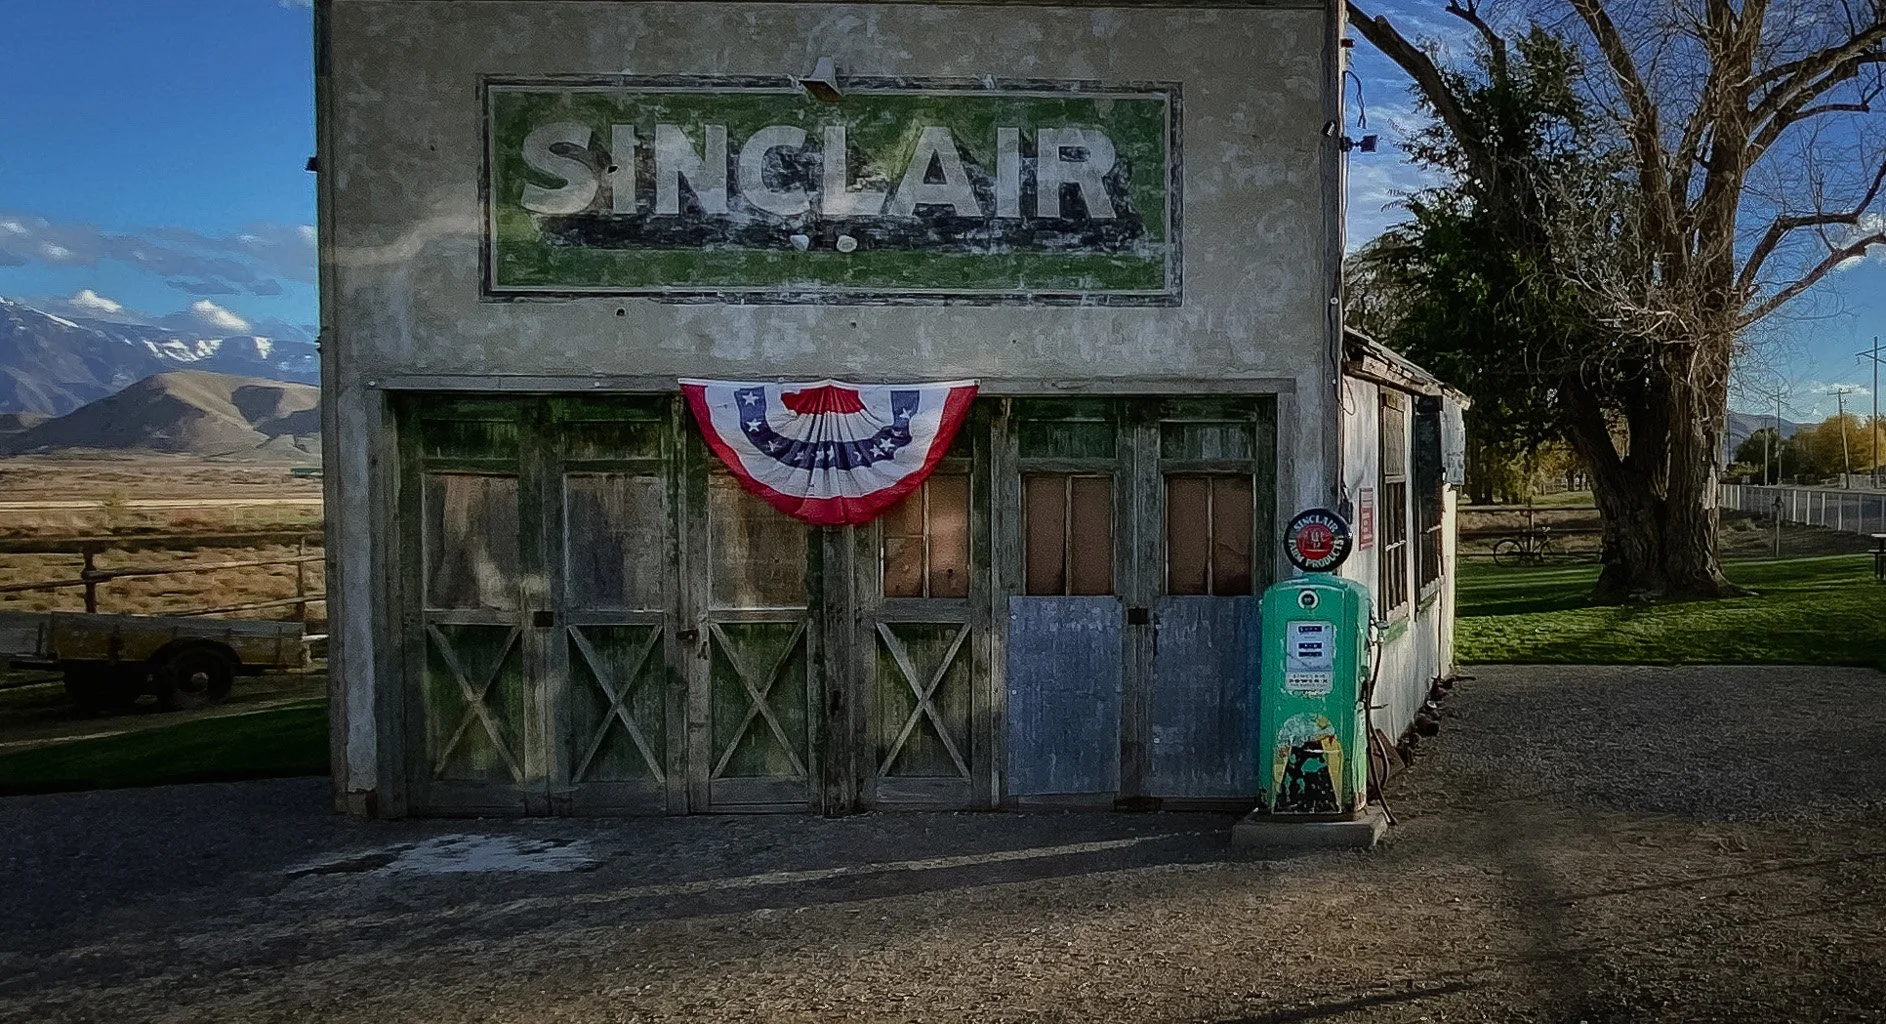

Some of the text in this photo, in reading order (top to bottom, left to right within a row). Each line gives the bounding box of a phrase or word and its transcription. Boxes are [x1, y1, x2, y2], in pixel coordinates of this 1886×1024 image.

[520, 121, 1117, 219] SINCLAIR
[1293, 515, 1339, 533] SINCLAIR
[1288, 538, 1305, 563] FARM
[1305, 535, 1345, 568] PRODUCTS
